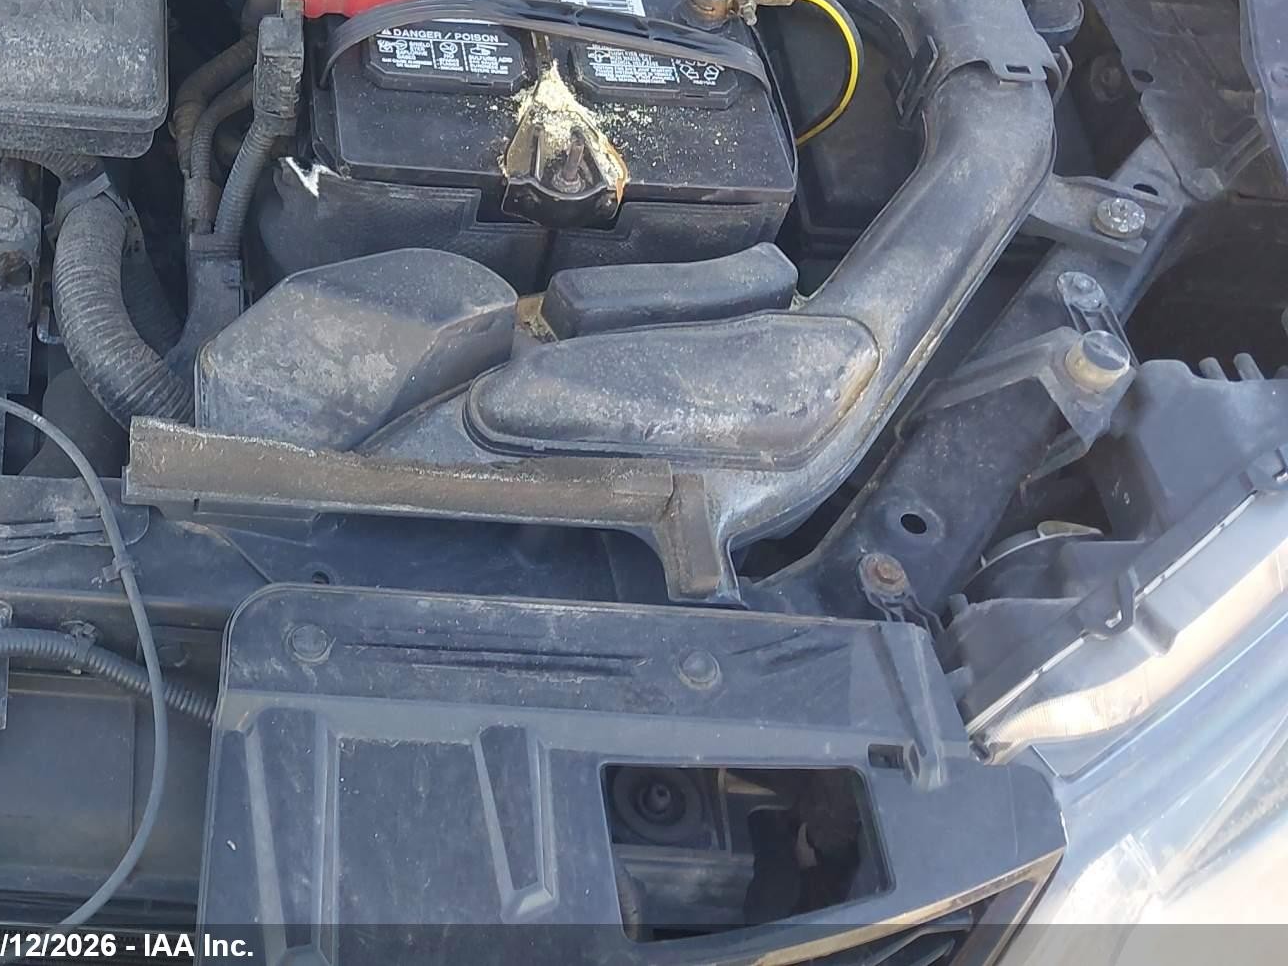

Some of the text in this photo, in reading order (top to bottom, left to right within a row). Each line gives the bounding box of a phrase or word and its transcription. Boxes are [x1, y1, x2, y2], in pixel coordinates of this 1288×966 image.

[393, 29, 499, 43] DANGER / POISON
